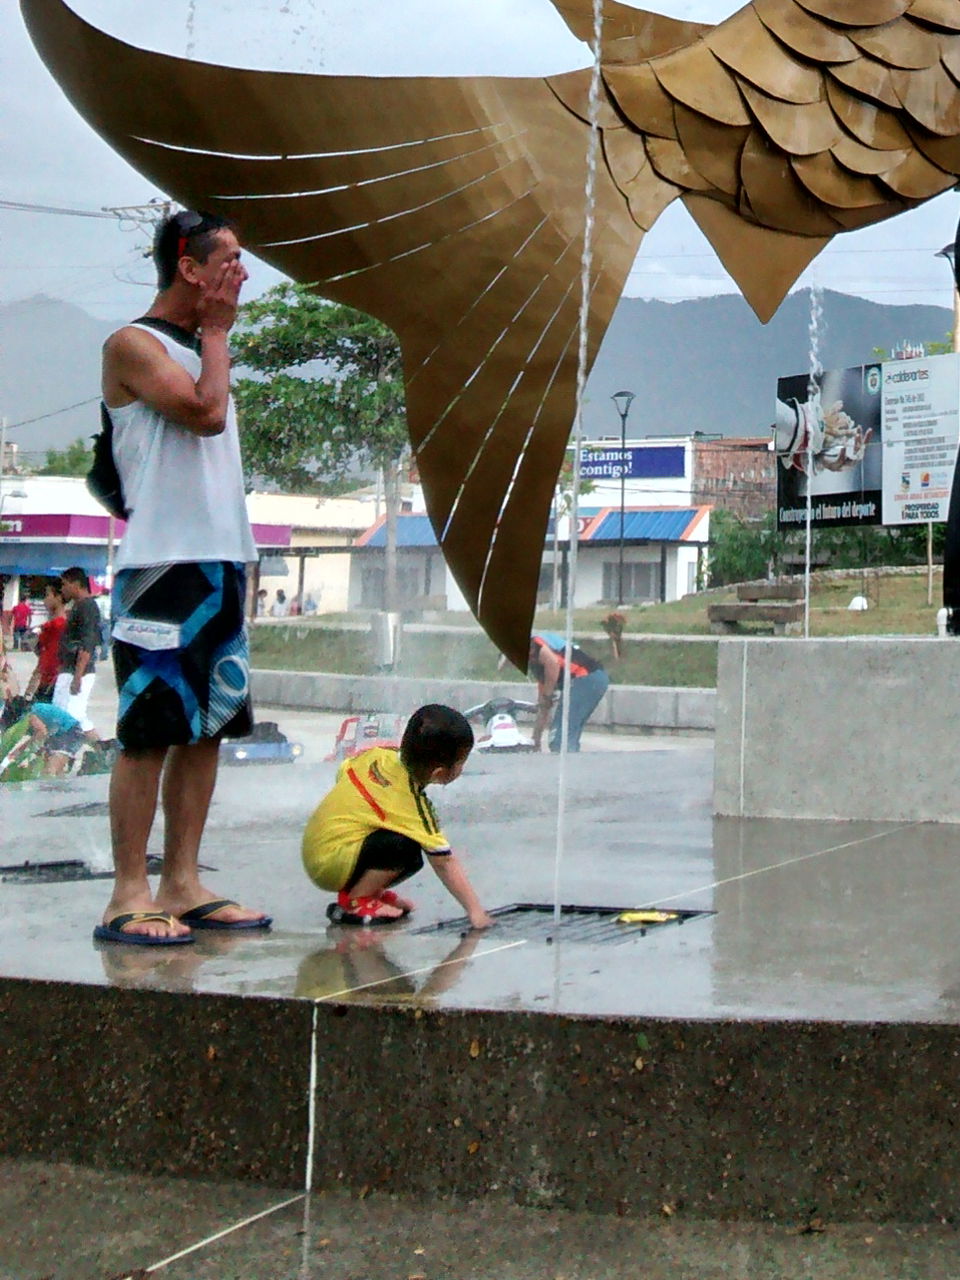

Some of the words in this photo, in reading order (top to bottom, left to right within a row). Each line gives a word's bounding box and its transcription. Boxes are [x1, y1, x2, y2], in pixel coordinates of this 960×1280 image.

[580, 449, 632, 462] Estamos
[580, 462, 632, 478] contigo!
[842, 501, 851, 518] del
[852, 500, 876, 520] deporte
[905, 502, 939, 511] PROSPERIDAD
[905, 511, 919, 520] PARA
[920, 510, 939, 520] TODOS
